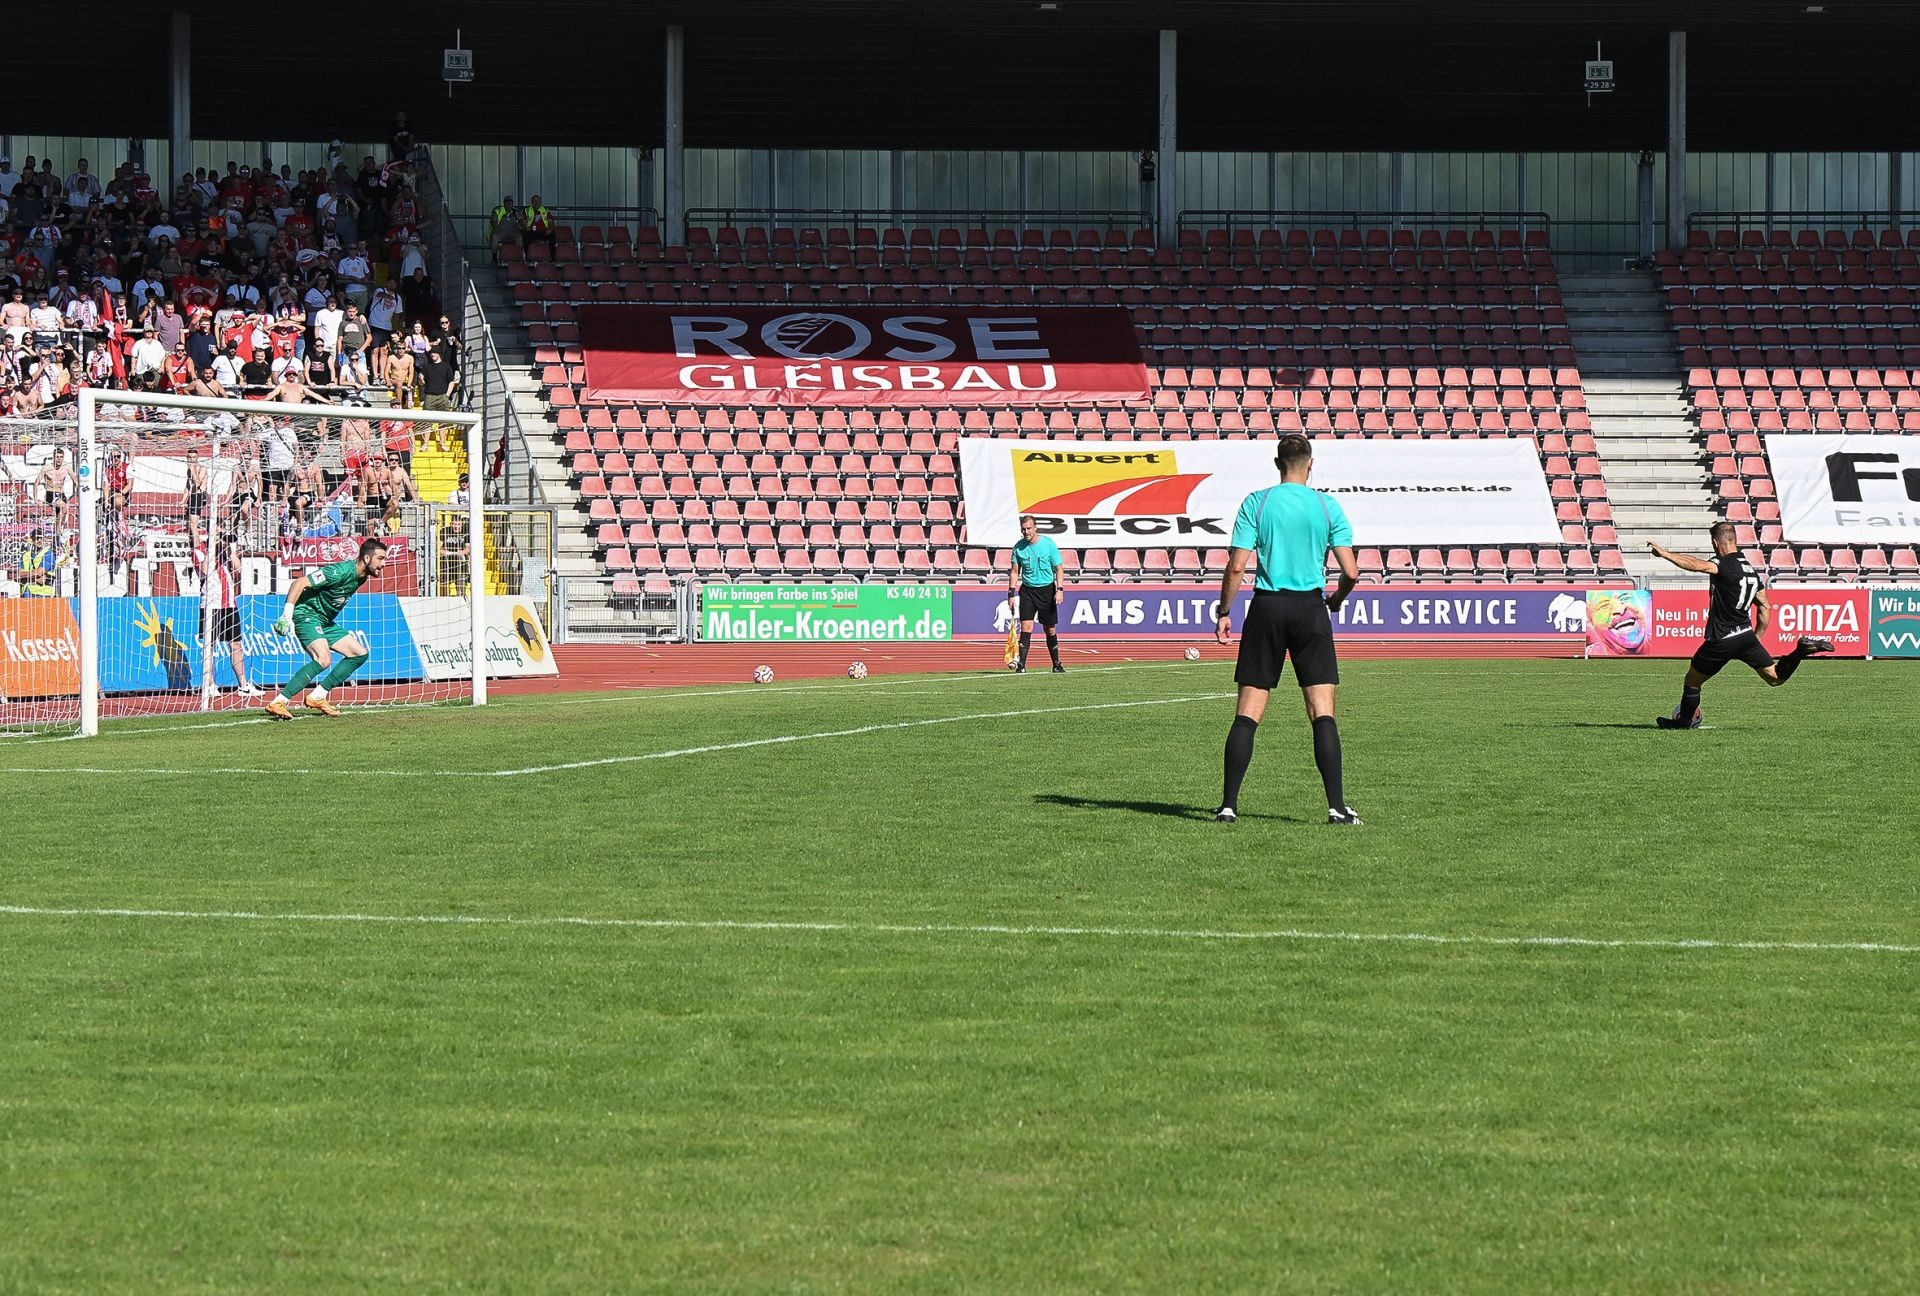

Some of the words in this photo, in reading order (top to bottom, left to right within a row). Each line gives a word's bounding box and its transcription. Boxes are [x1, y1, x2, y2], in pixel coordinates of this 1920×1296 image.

[670, 312, 1052, 361] ROSE
[679, 363, 1057, 392] GLEISBAU
[1023, 452, 1160, 464] Albert
[1311, 485, 1513, 493] w.albert-beck.de
[1020, 516, 1228, 535] BECK
[707, 588, 728, 600] Wir
[731, 587, 774, 603] bringen
[777, 588, 808, 600] Farbe
[811, 588, 828, 600] ins
[831, 588, 858, 603] Spiel
[887, 587, 899, 599] KS
[902, 587, 915, 599] 40
[918, 587, 931, 599] 24
[935, 587, 947, 599] 13
[1736, 576, 1759, 611] 17
[1070, 599, 1145, 625] AHS
[1400, 599, 1517, 625] SERVICE
[1656, 608, 1682, 621] Neu
[1686, 607, 1699, 621] in
[1879, 597, 1904, 612] Wir
[707, 609, 947, 639] Maler-Kroenert.de
[1, 627, 80, 662] Kassel
[1778, 633, 1796, 642] Wir
[1834, 633, 1860, 643] Farbe
[420, 642, 468, 670] Tierpark
[469, 641, 523, 668] aburg
